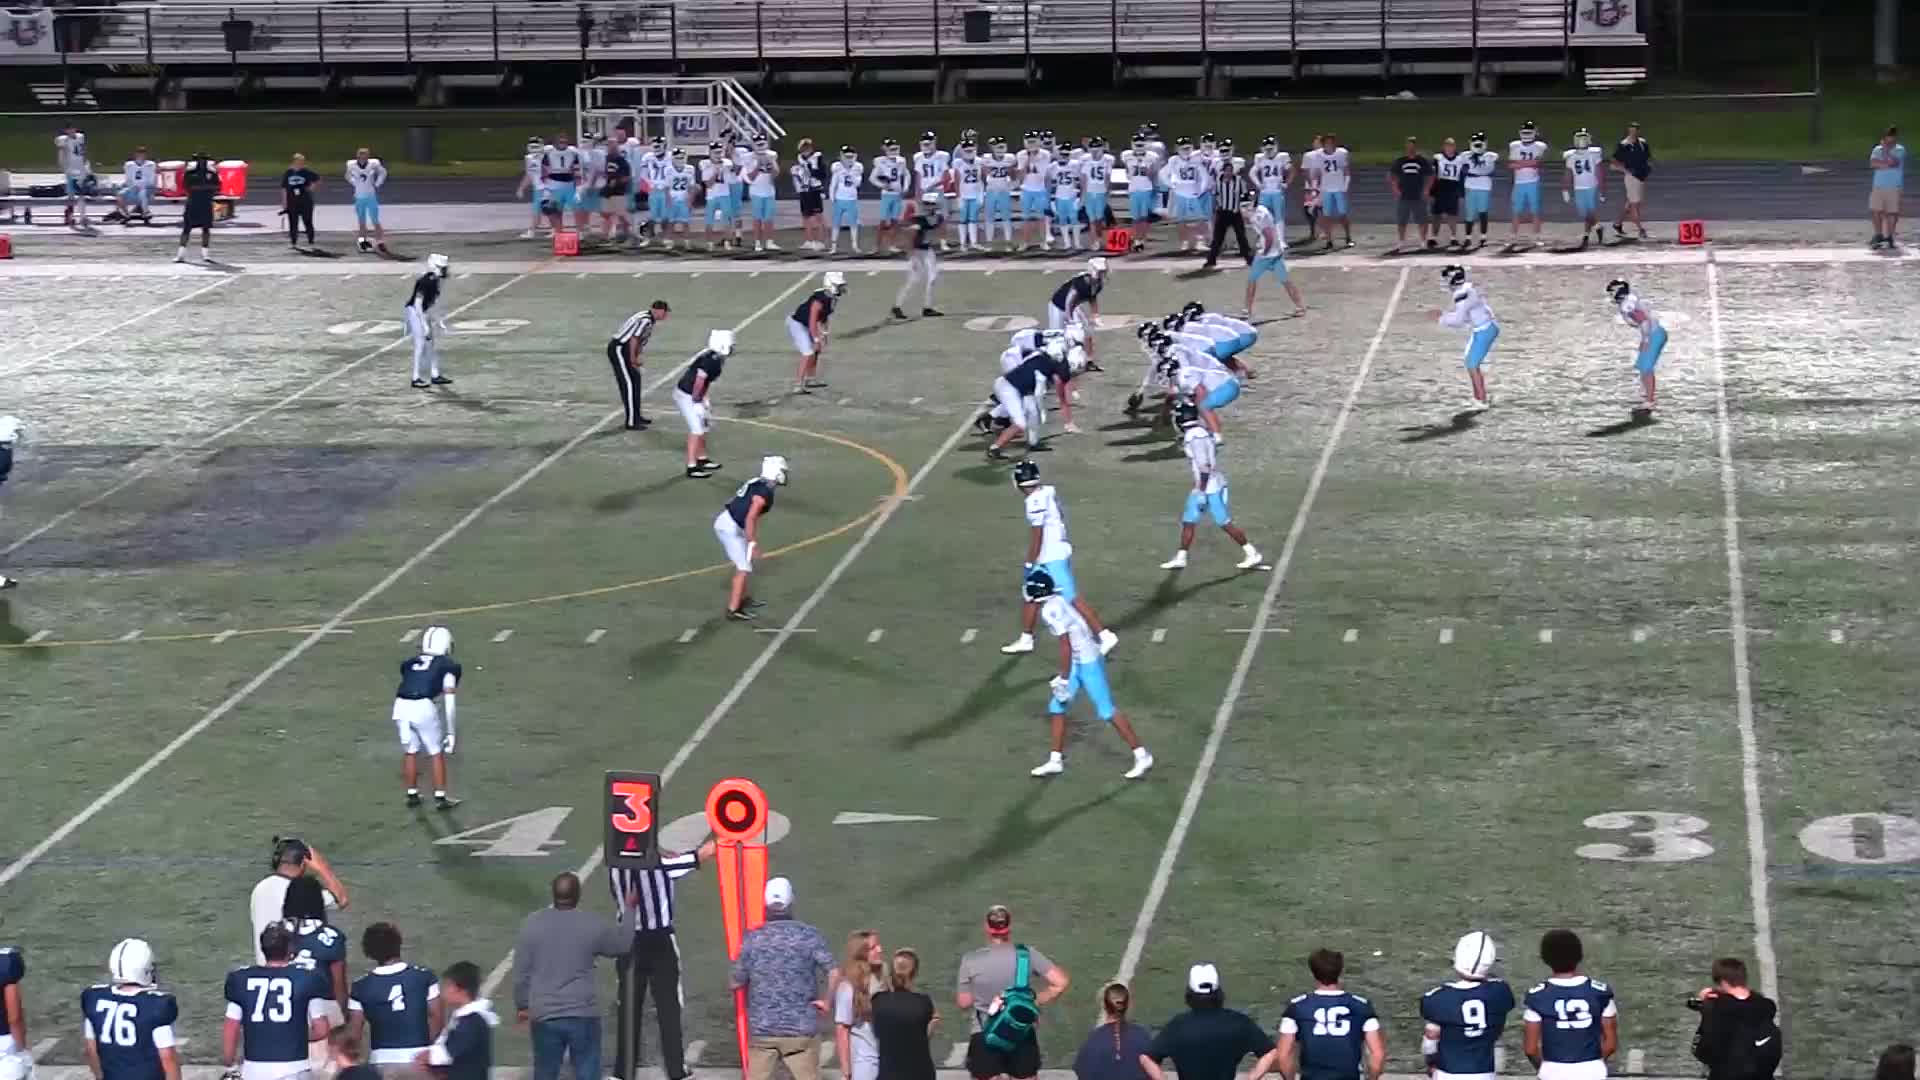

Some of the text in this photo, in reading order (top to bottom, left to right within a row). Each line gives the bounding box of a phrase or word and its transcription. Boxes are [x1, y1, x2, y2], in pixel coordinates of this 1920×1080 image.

[672, 178, 689, 191] 22
[1109, 231, 1128, 249] 40
[1683, 223, 1702, 240] 30
[612, 782, 652, 833] 3
[247, 978, 293, 1023] 73
[1554, 999, 1593, 1028] 13
[96, 999, 138, 1047] 76
[1313, 1006, 1351, 1036] 16
[1462, 999, 1488, 1037] 9
